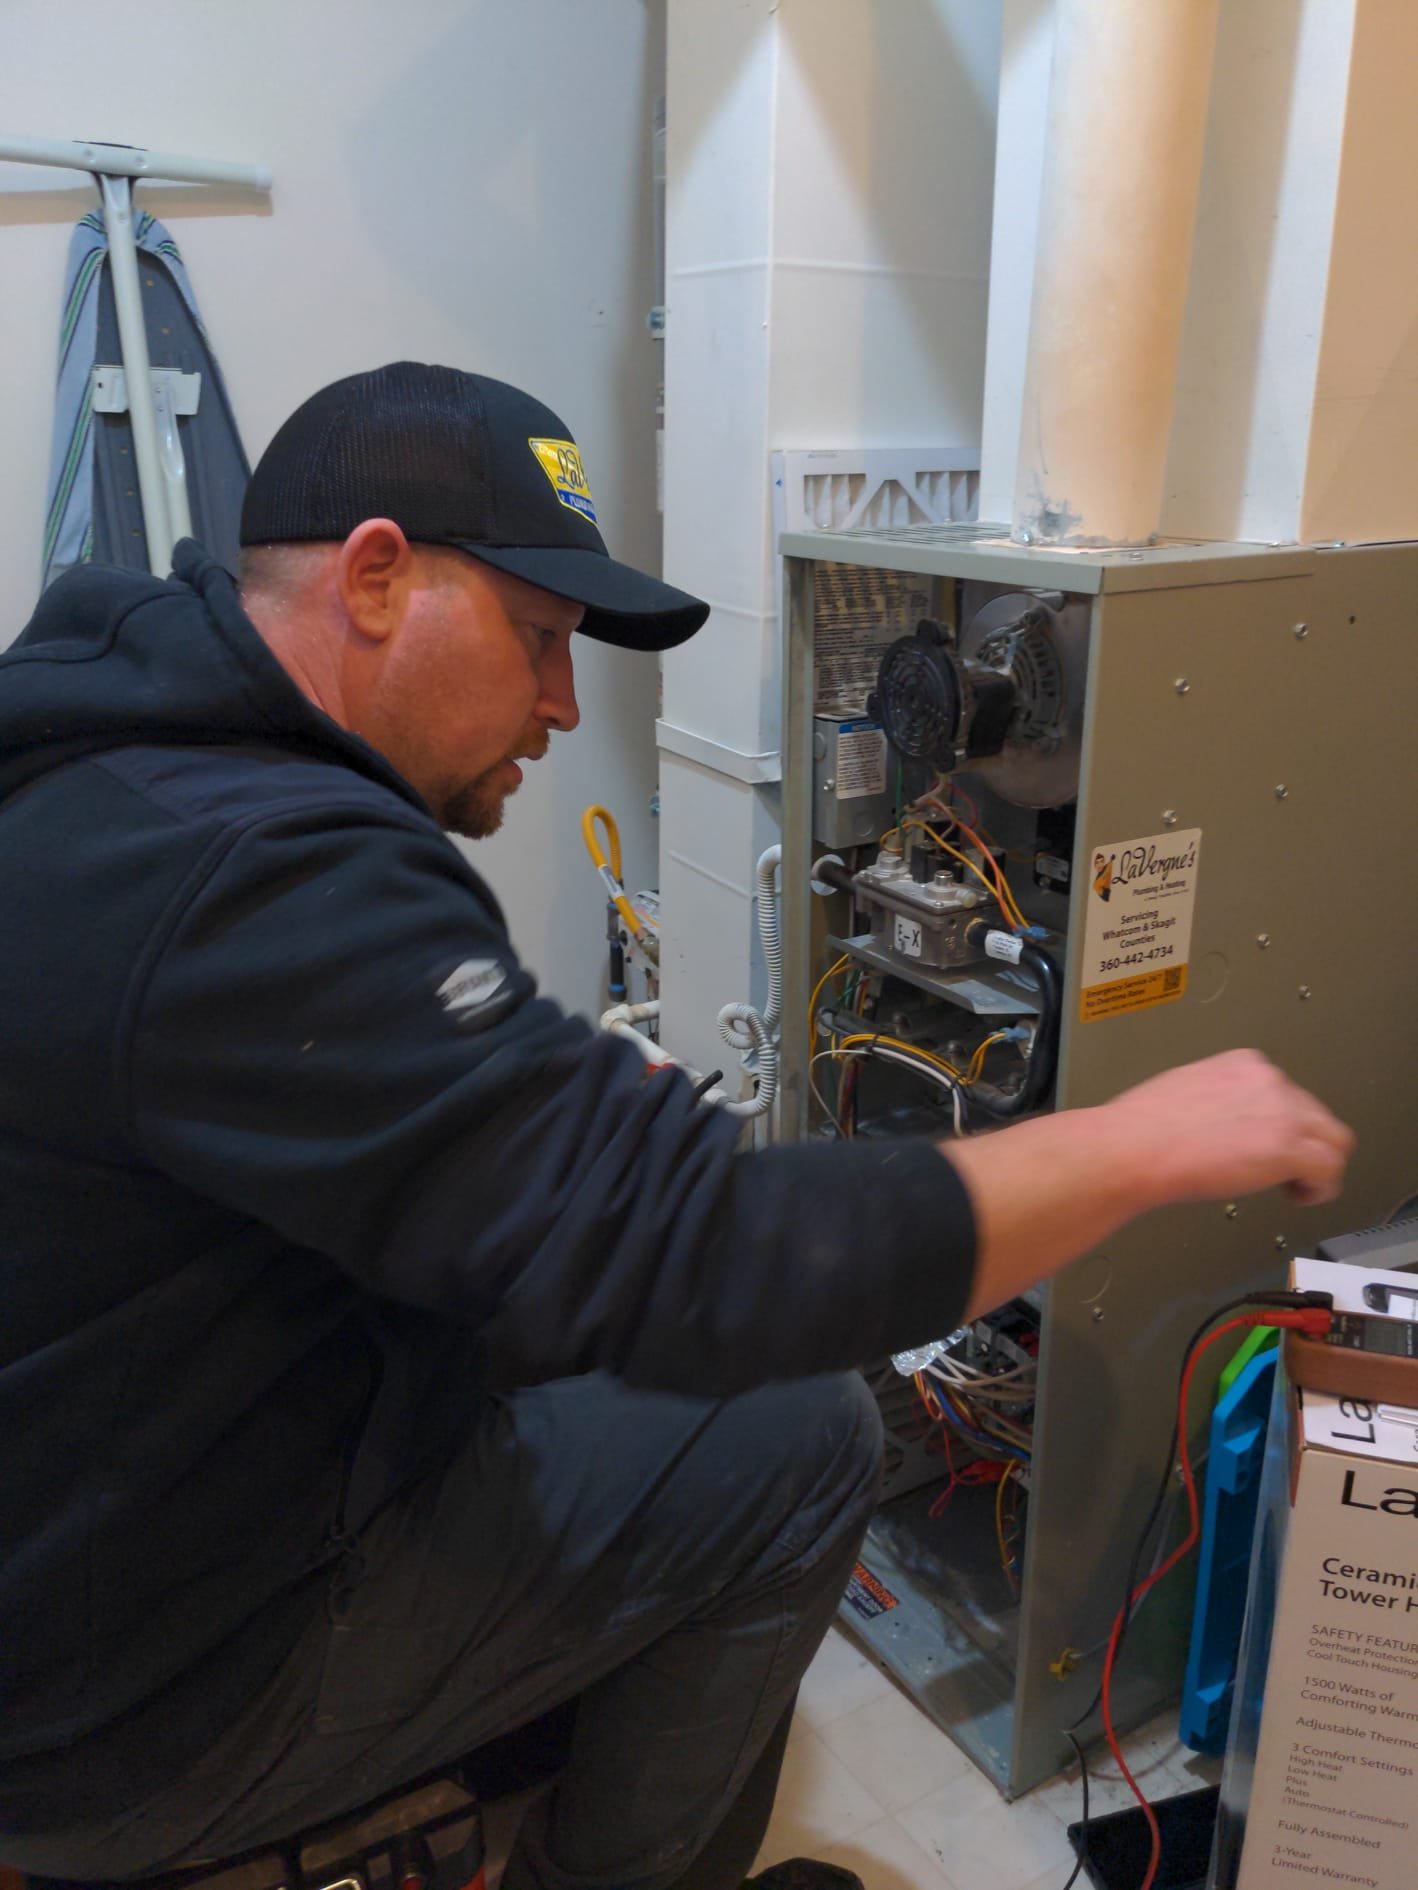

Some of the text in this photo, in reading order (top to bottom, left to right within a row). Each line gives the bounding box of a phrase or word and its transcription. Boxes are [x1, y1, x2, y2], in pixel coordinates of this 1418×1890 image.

[1112, 841, 1195, 885] LaVergne's
[1121, 910, 1159, 924] Servicing
[1103, 917, 1176, 940] Whatcom & Skagit
[1120, 935, 1155, 948] Counties
[1100, 945, 1173, 972] 360-442-4734
[1341, 1470, 1418, 1519] La
[1322, 1557, 1418, 1590] Cerami
[1319, 1579, 1399, 1609] Tower
[1311, 1624, 1363, 1643] SAFETY
[1309, 1637, 1360, 1655] Overheat
[1307, 1649, 1333, 1661] Cool
[1335, 1654, 1369, 1668] Touch
[1304, 1676, 1395, 1701] 1500 Watts of
[1300, 1689, 1377, 1715] Comforting
[1295, 1716, 1367, 1738] Adjustable
[1289, 1754, 1343, 1772] High Heat
[1291, 1742, 1414, 1777] 3 Comfort Settings
[1285, 1775, 1308, 1787] Plus
[1287, 1764, 1338, 1782] Low Heat
[1284, 1786, 1310, 1798] Auto
[1278, 1819, 1381, 1849] Fully Assembled
[1273, 1844, 1312, 1860] 3-Year
[1271, 1857, 1379, 1888] Limited Warranty
